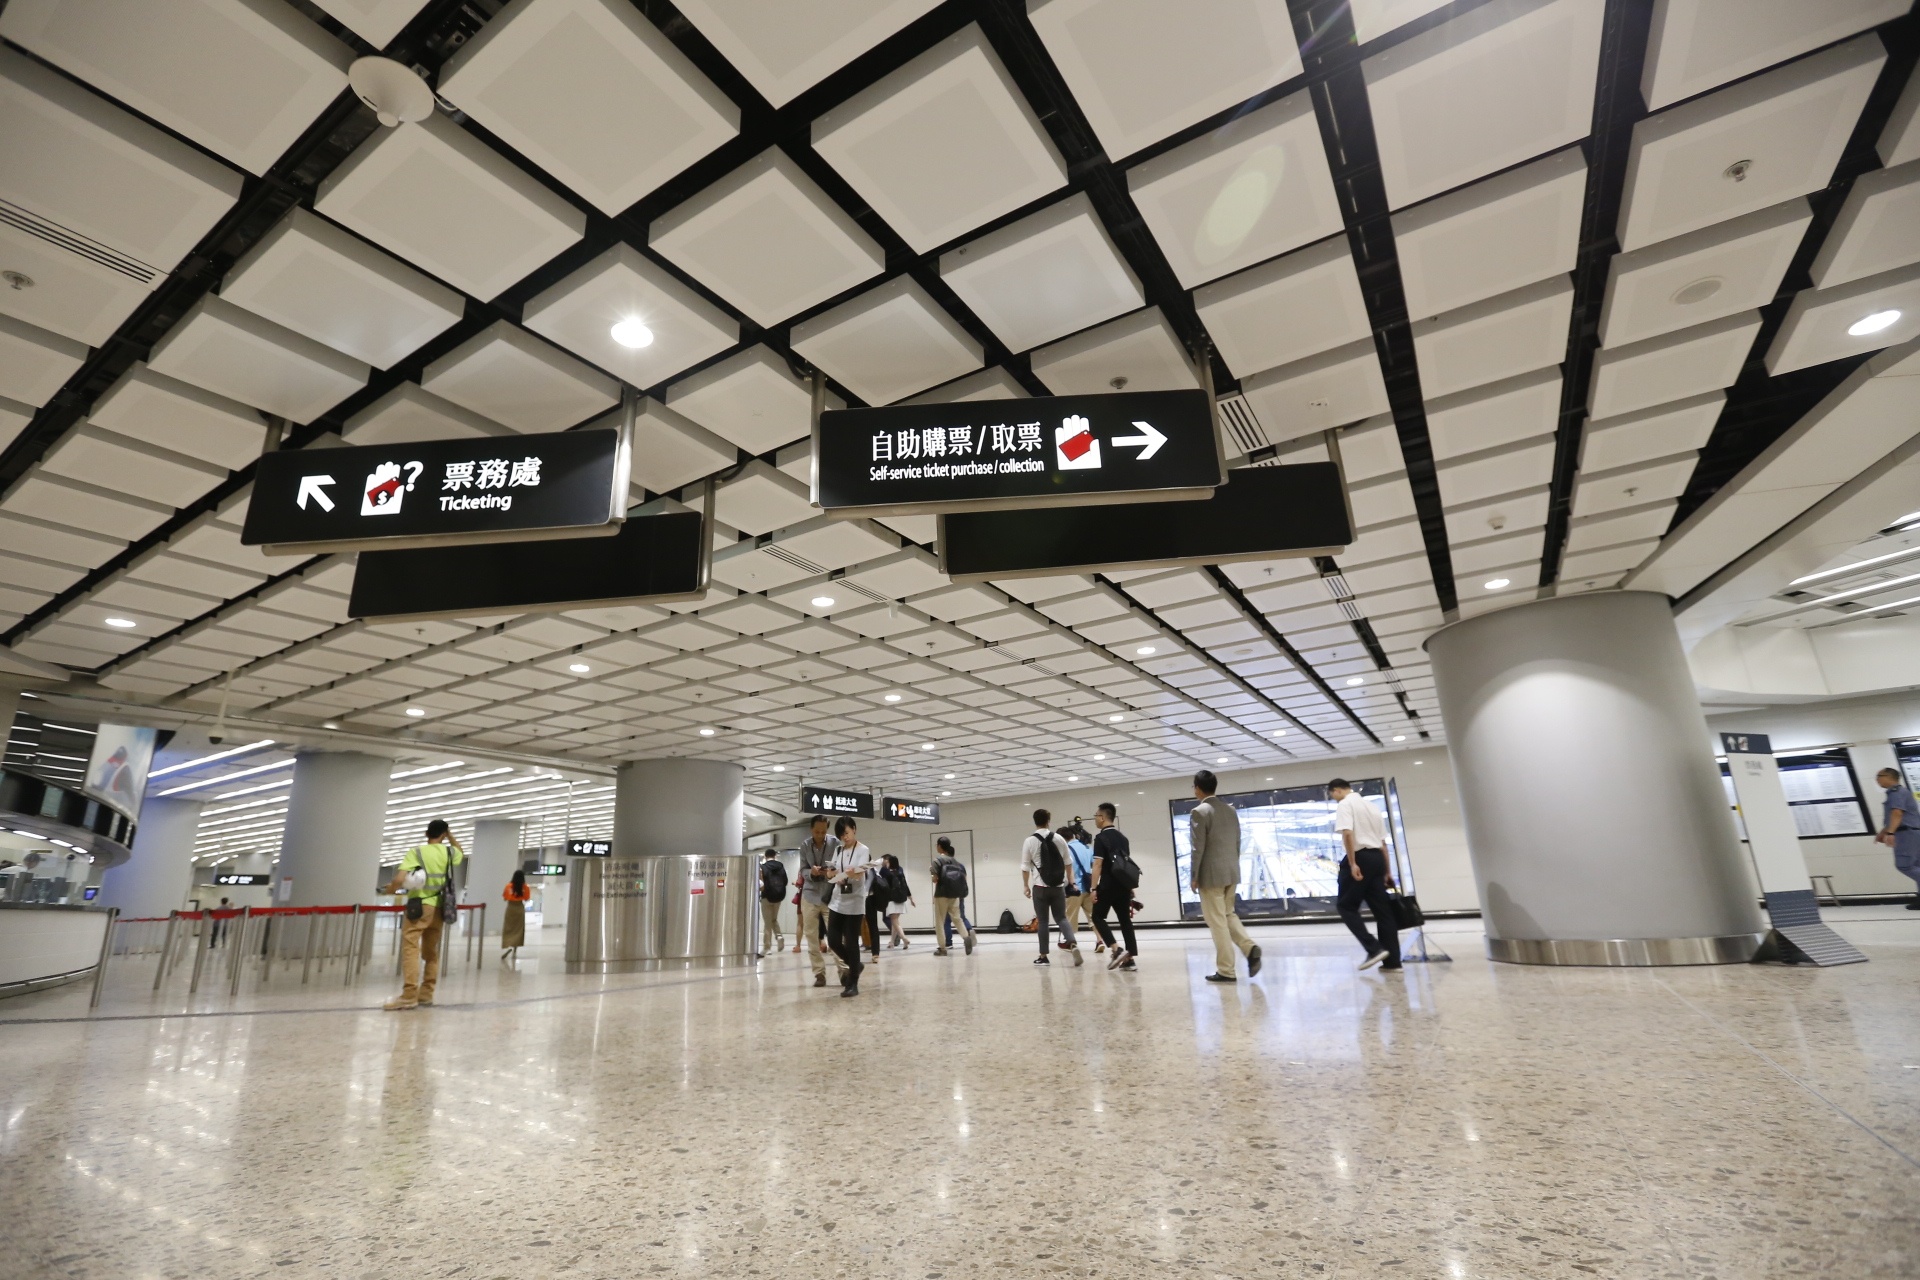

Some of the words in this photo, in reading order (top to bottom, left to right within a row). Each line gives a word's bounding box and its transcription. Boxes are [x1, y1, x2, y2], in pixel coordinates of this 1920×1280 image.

[871, 421, 1043, 462] 自助購票/取票
[440, 456, 543, 491] 票務處
[869, 464, 922, 481] Self-service
[923, 462, 950, 478] ticket
[951, 460, 993, 479] purchase
[999, 458, 1045, 474] collection
[439, 494, 512, 512] Ticketing
